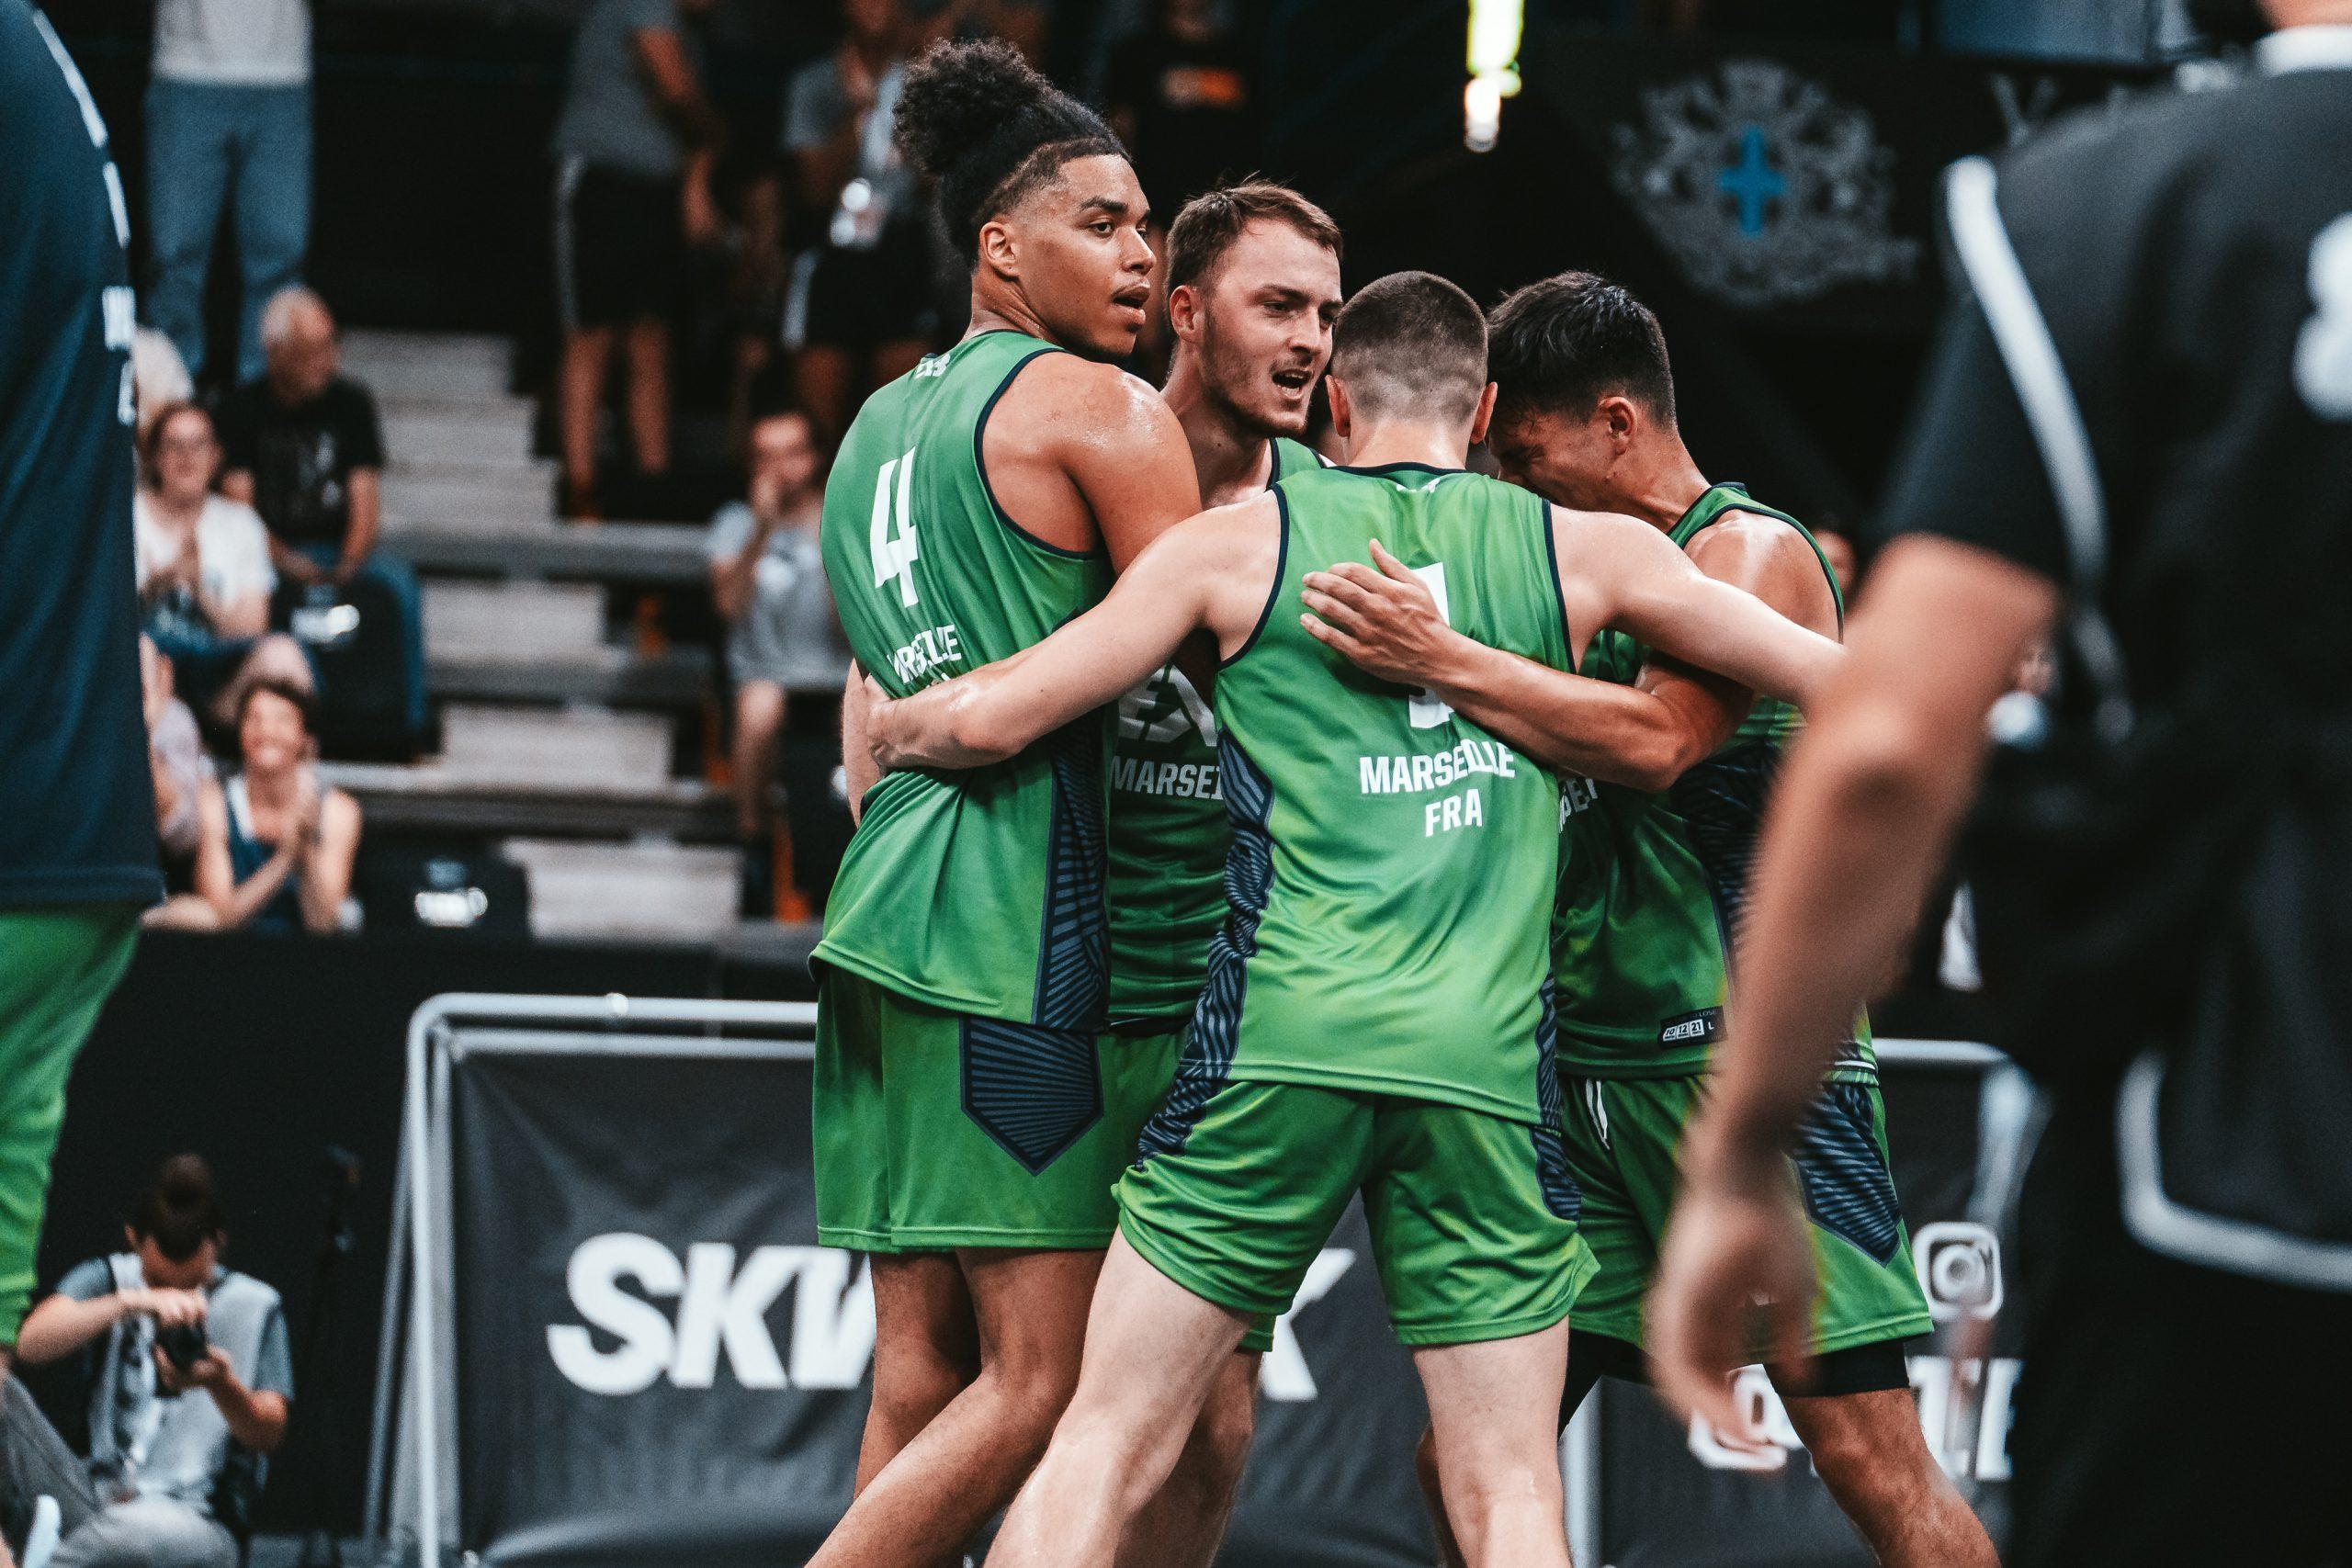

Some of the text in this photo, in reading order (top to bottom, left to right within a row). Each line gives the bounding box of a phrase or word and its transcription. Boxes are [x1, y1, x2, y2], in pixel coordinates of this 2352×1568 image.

[870, 447, 919, 608] 4
[1425, 789, 1483, 838] FRA
[1679, 1024, 1688, 1033] 12
[1691, 1021, 1702, 1032] 21
[1708, 1021, 1714, 1030] L
